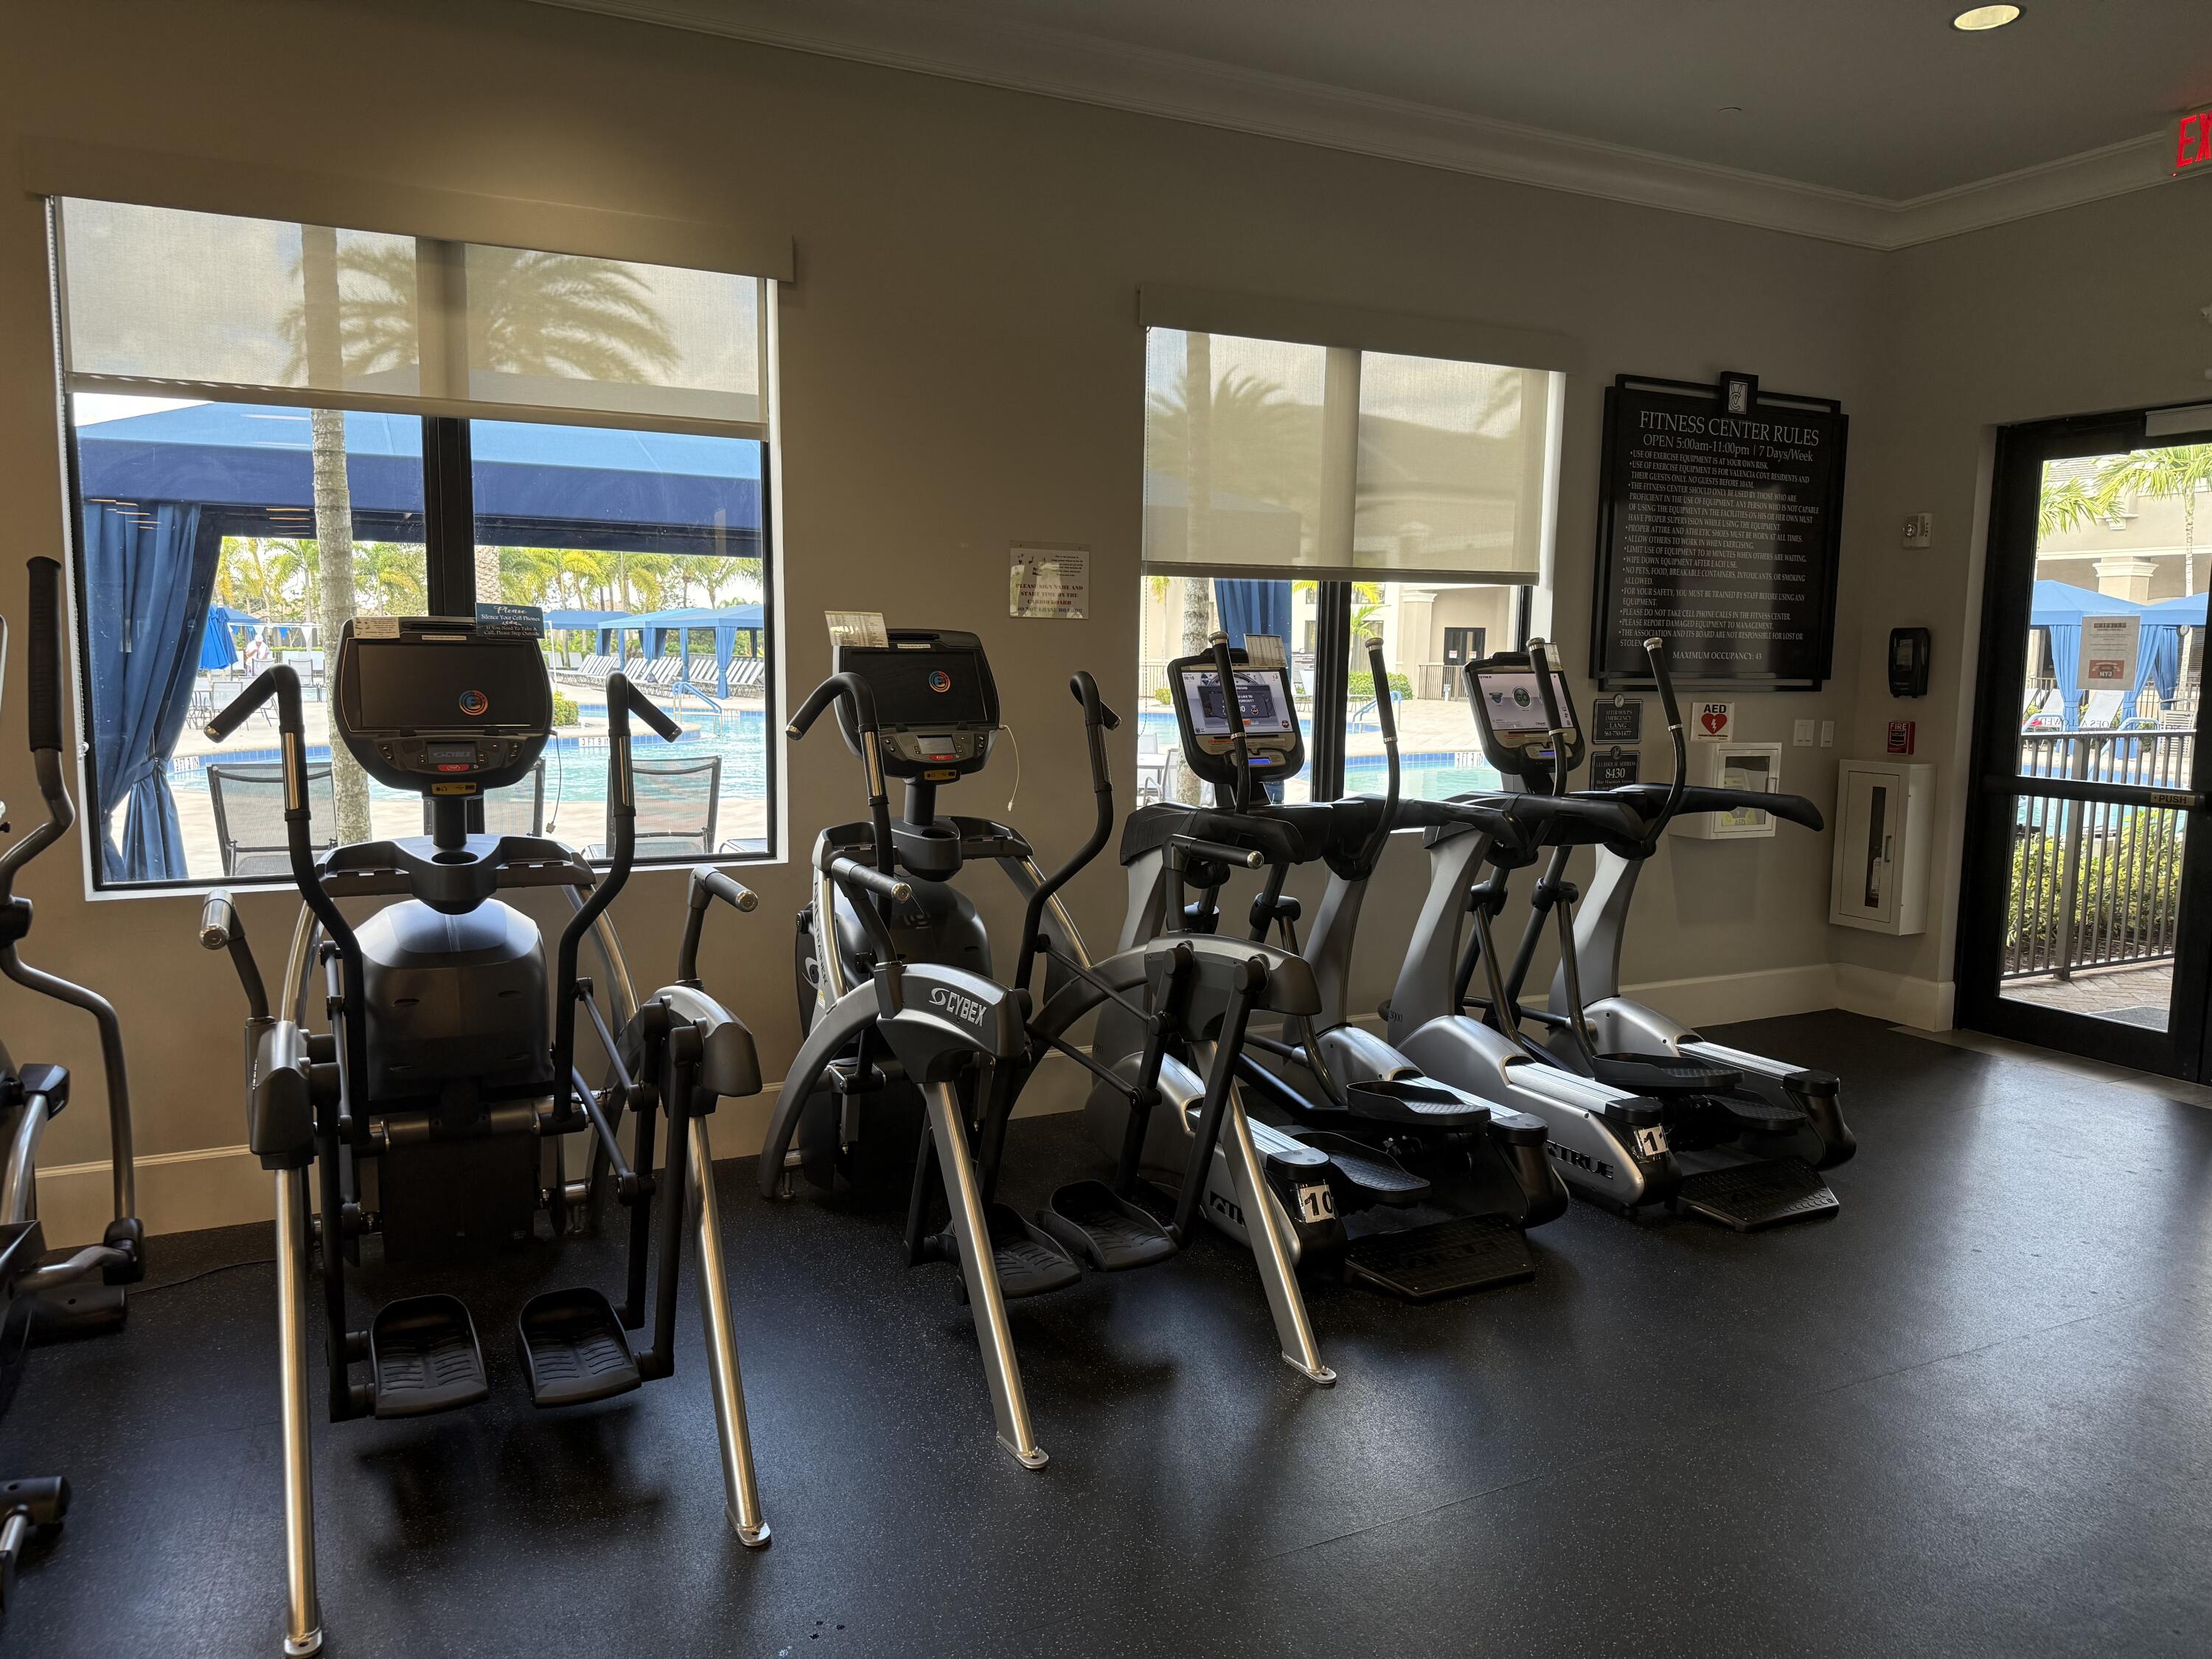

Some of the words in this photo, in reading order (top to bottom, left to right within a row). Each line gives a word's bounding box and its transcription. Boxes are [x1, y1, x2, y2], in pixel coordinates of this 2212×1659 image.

[1639, 411, 1705, 434] FITNESS
[1708, 418, 1770, 442] CENTER
[1773, 425, 1820, 446] RULES
[1643, 434, 1674, 448] OPEN
[1676, 437, 1750, 458] 5:00am-11:00pm
[1759, 445, 1765, 456] 7
[1767, 446, 1813, 462] Days/Week
[1633, 450, 1644, 459] USE
[1645, 451, 1652, 459] OF
[1654, 452, 1679, 462] EXERCISE
[1680, 454, 1711, 466] EQUIPMENT
[1712, 457, 1718, 465] IS
[1719, 458, 1725, 466] AT
[1727, 459, 1742, 467] YOUR
[1742, 460, 1755, 469] OWN
[1631, 471, 1648, 480] THEIR
[1649, 473, 1671, 482] GUESTS
[1688, 476, 1697, 484] NO
[1698, 476, 1718, 486] GUESTS
[1719, 479, 1739, 488] BEFORE
[1632, 460, 1643, 469] USE
[1644, 462, 1652, 470] OF
[1653, 462, 1678, 472] EXERCISE
[1679, 465, 1711, 476] EQUIPMENT
[1712, 467, 1717, 476] IS
[1718, 468, 1728, 476] FOR
[1730, 469, 1755, 479] VALENCIA
[1756, 471, 1770, 481] COVE
[1771, 473, 1798, 483] RESIDENTS
[1798, 476, 1809, 484] AND
[1631, 481, 1642, 490] THE
[1644, 482, 1666, 492] FITNESS
[1666, 484, 1688, 494] CENTER
[1689, 486, 1711, 495] SHOULD
[1712, 488, 1727, 497] ONLY
[1728, 490, 1734, 498] BE
[1735, 490, 1748, 498] USED
[1749, 491, 1756, 499] BY
[1757, 492, 1774, 501] THOSE
[1775, 493, 1787, 501] WHO
[1787, 494, 1796, 502] ARE
[1630, 493, 1663, 502] PROFICIENT
[1664, 495, 1670, 503] IN
[1672, 495, 1682, 504] THE
[1683, 497, 1694, 505] USE
[1695, 498, 1702, 506] OF
[1736, 501, 1747, 509] ANY
[1747, 501, 1767, 511] PERSON
[1768, 504, 1781, 512] WHO
[1781, 504, 1786, 512] IS
[1787, 505, 1798, 513] NOT
[1798, 506, 1819, 515] CAPABLE
[1628, 524, 1649, 533] PROPER
[1651, 526, 1670, 535] ATTIRE
[1672, 527, 1684, 535] AND
[1686, 528, 1711, 537] ATHLETIC
[1712, 529, 1728, 538] SHOES
[1730, 531, 1745, 539] MUST
[1746, 532, 1752, 540] BE
[1753, 532, 1768, 540] WORN
[1770, 533, 1776, 541] AT
[1777, 534, 1787, 542] ALL
[1628, 535, 1647, 543] ALLOW
[1649, 537, 1672, 545] OTHERS
[1672, 538, 1680, 546] TO
[1681, 538, 1697, 546] WORK
[1699, 539, 1705, 547] IN
[1706, 540, 1722, 548] WHEN
[494, 605, 528, 614] Please
[1696, 611, 1714, 619] PHONE
[1672, 651, 1709, 659] MAXIMUM
[1711, 652, 1755, 660] OCCUPANCY:
[1703, 704, 1727, 714] AED
[1605, 768, 1626, 779] 8430
[2159, 795, 2187, 804] PUSH
[946, 992, 988, 1027] CYBEX
[1304, 1191, 1333, 1217] 10
